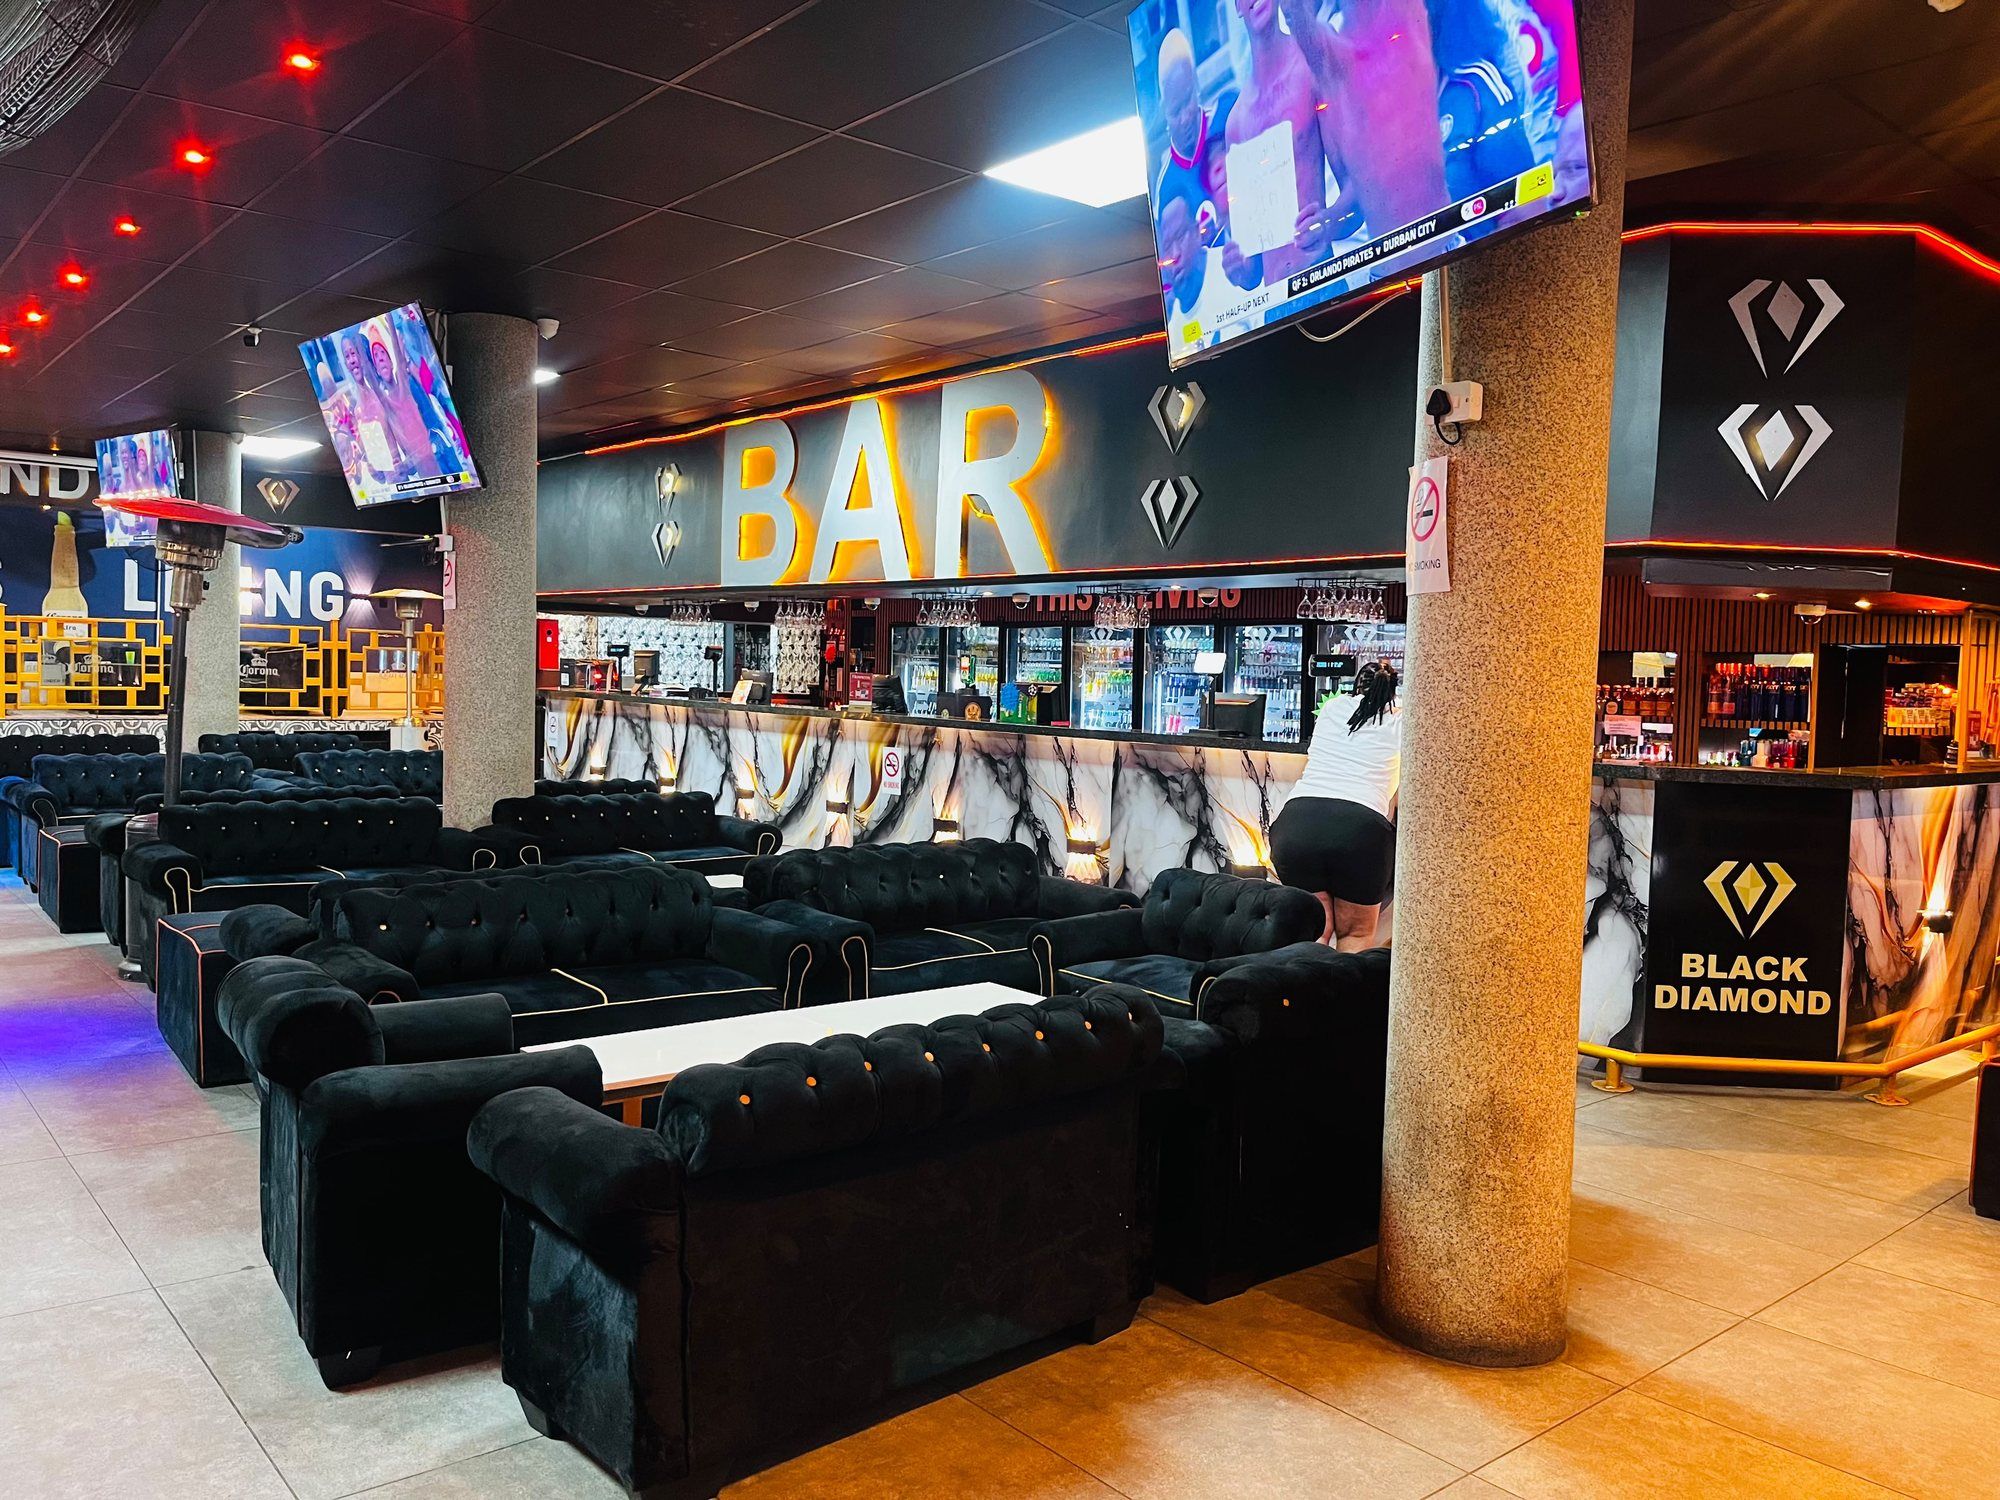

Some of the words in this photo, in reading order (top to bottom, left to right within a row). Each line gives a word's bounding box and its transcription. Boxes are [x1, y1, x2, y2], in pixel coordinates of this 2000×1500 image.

[1310, 260, 1342, 284] ORLANDO
[1342, 246, 1374, 270] PIRATES
[1375, 246, 1381, 256] v
[1383, 227, 1416, 253] DURBAN
[1417, 219, 1436, 238] CITY
[1253, 292, 1270, 307] NEXT
[721, 369, 1052, 586] BAR
[1414, 559, 1441, 571] SMOKING
[239, 664, 280, 678] Corona
[1239, 665, 1284, 678] DIAMOND
[1681, 953, 1808, 982] BLACK
[1654, 984, 1831, 1016] DIAMOND
